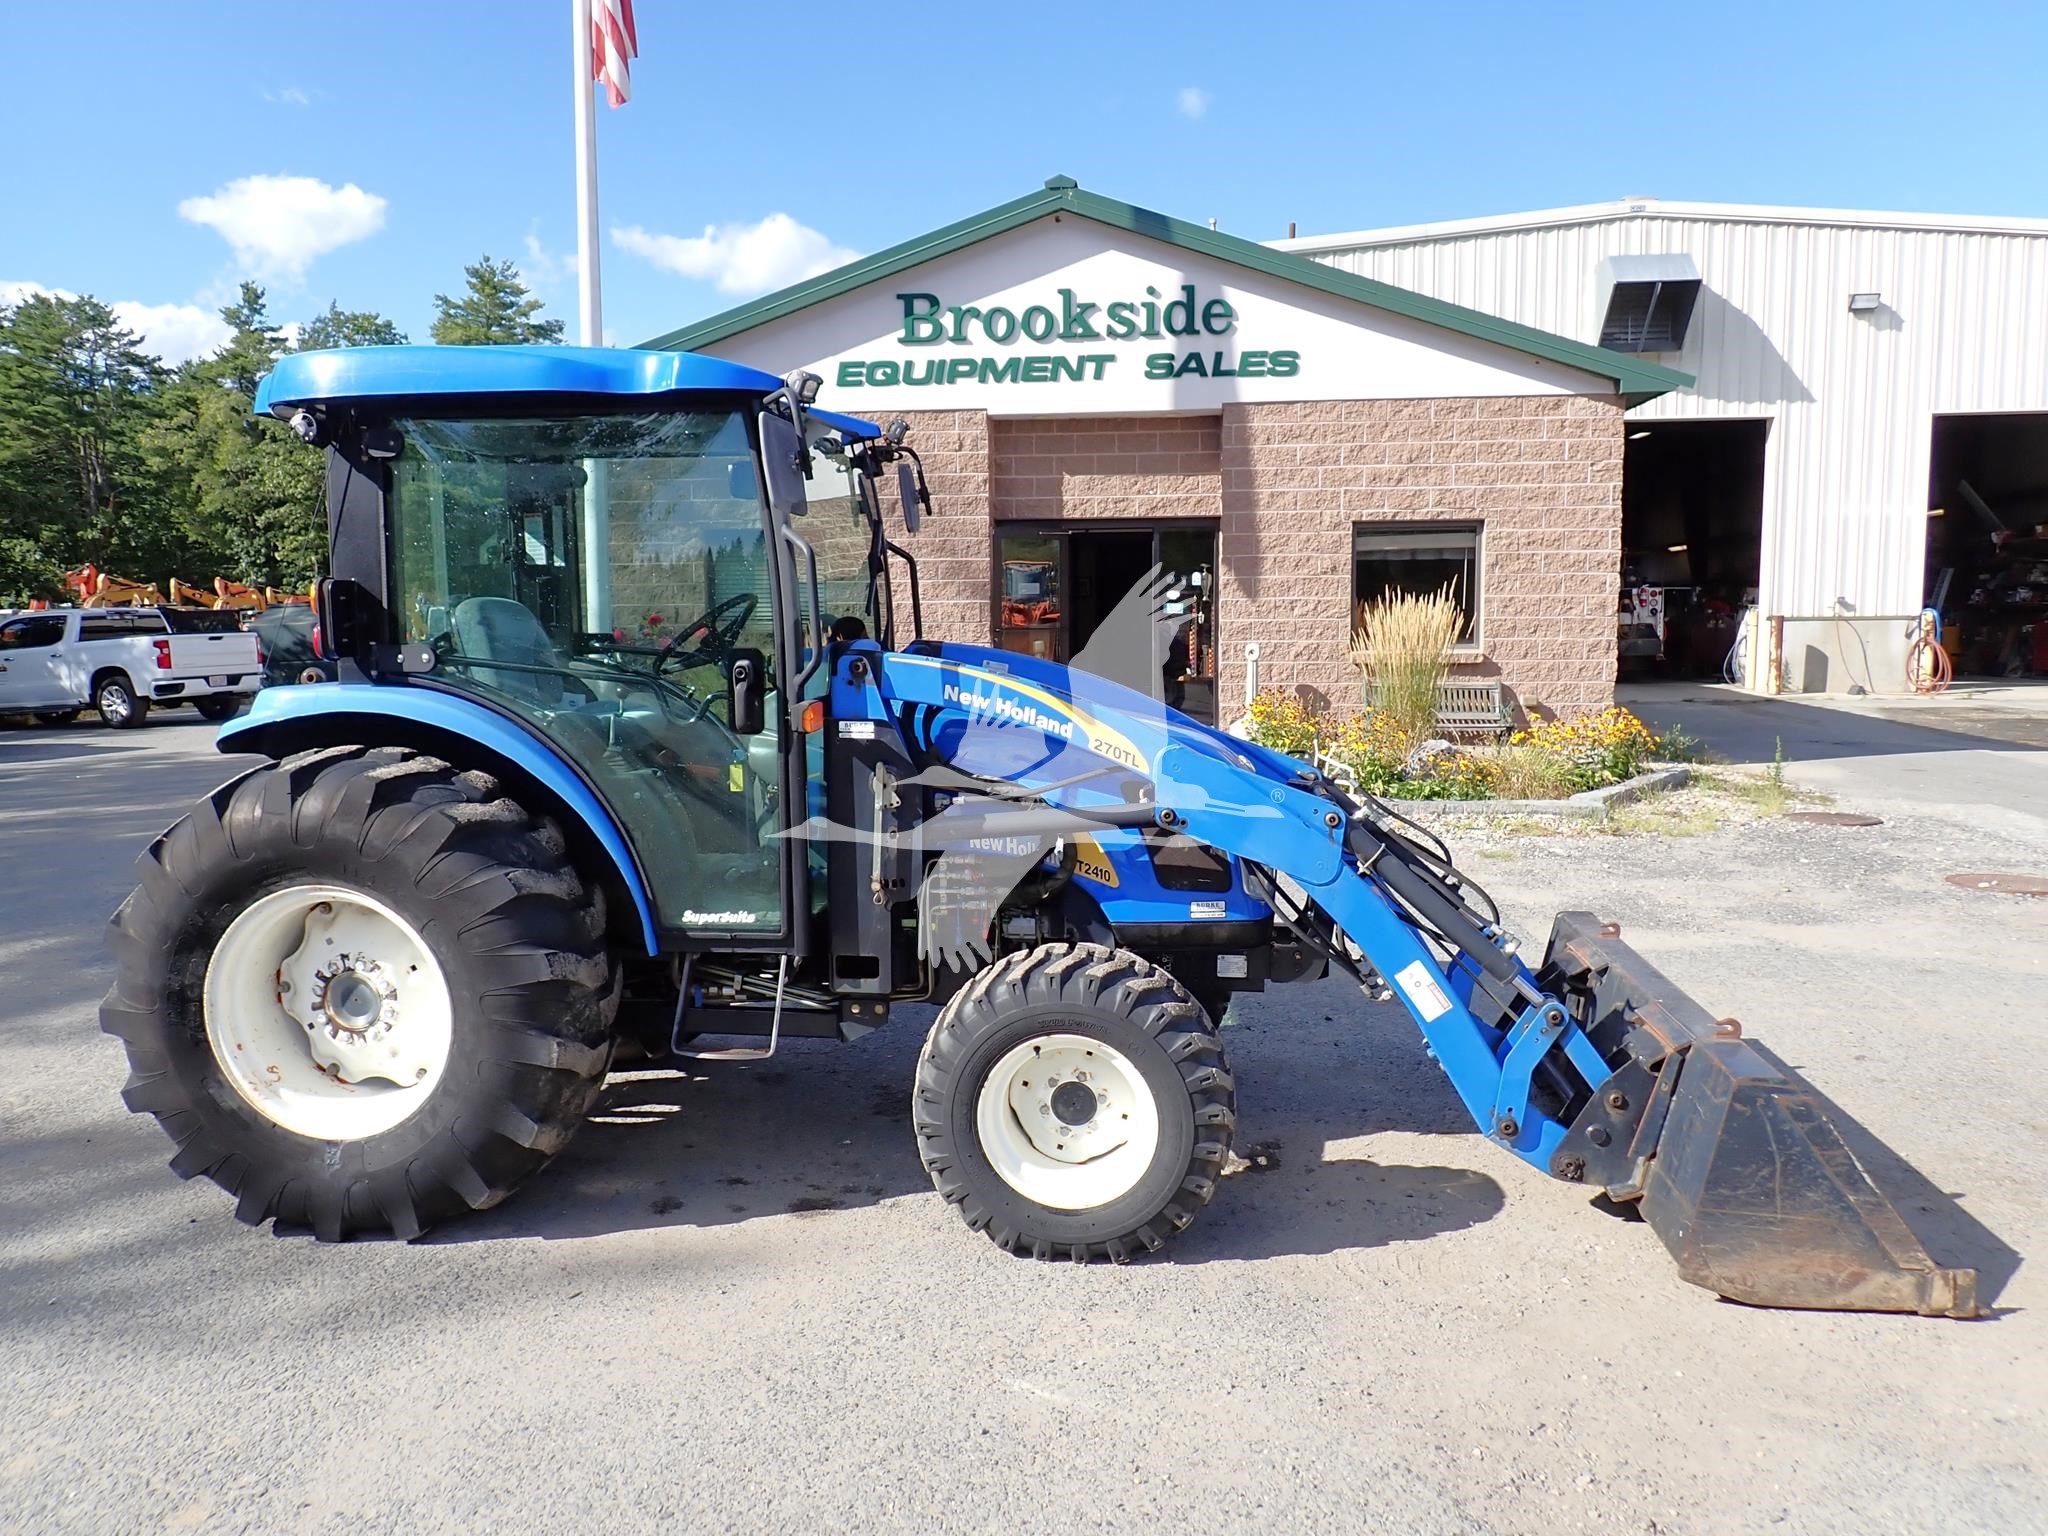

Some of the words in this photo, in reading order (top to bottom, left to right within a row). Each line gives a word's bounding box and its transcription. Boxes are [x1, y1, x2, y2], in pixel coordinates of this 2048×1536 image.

[896, 284, 1235, 344] Brookside
[836, 353, 1116, 387] EQUIPMENT
[1144, 350, 1301, 379] SALES
[944, 684, 992, 711] New
[995, 698, 1074, 739] Holland
[1094, 738, 1141, 769] 270TL
[1076, 859, 1111, 882] T2410
